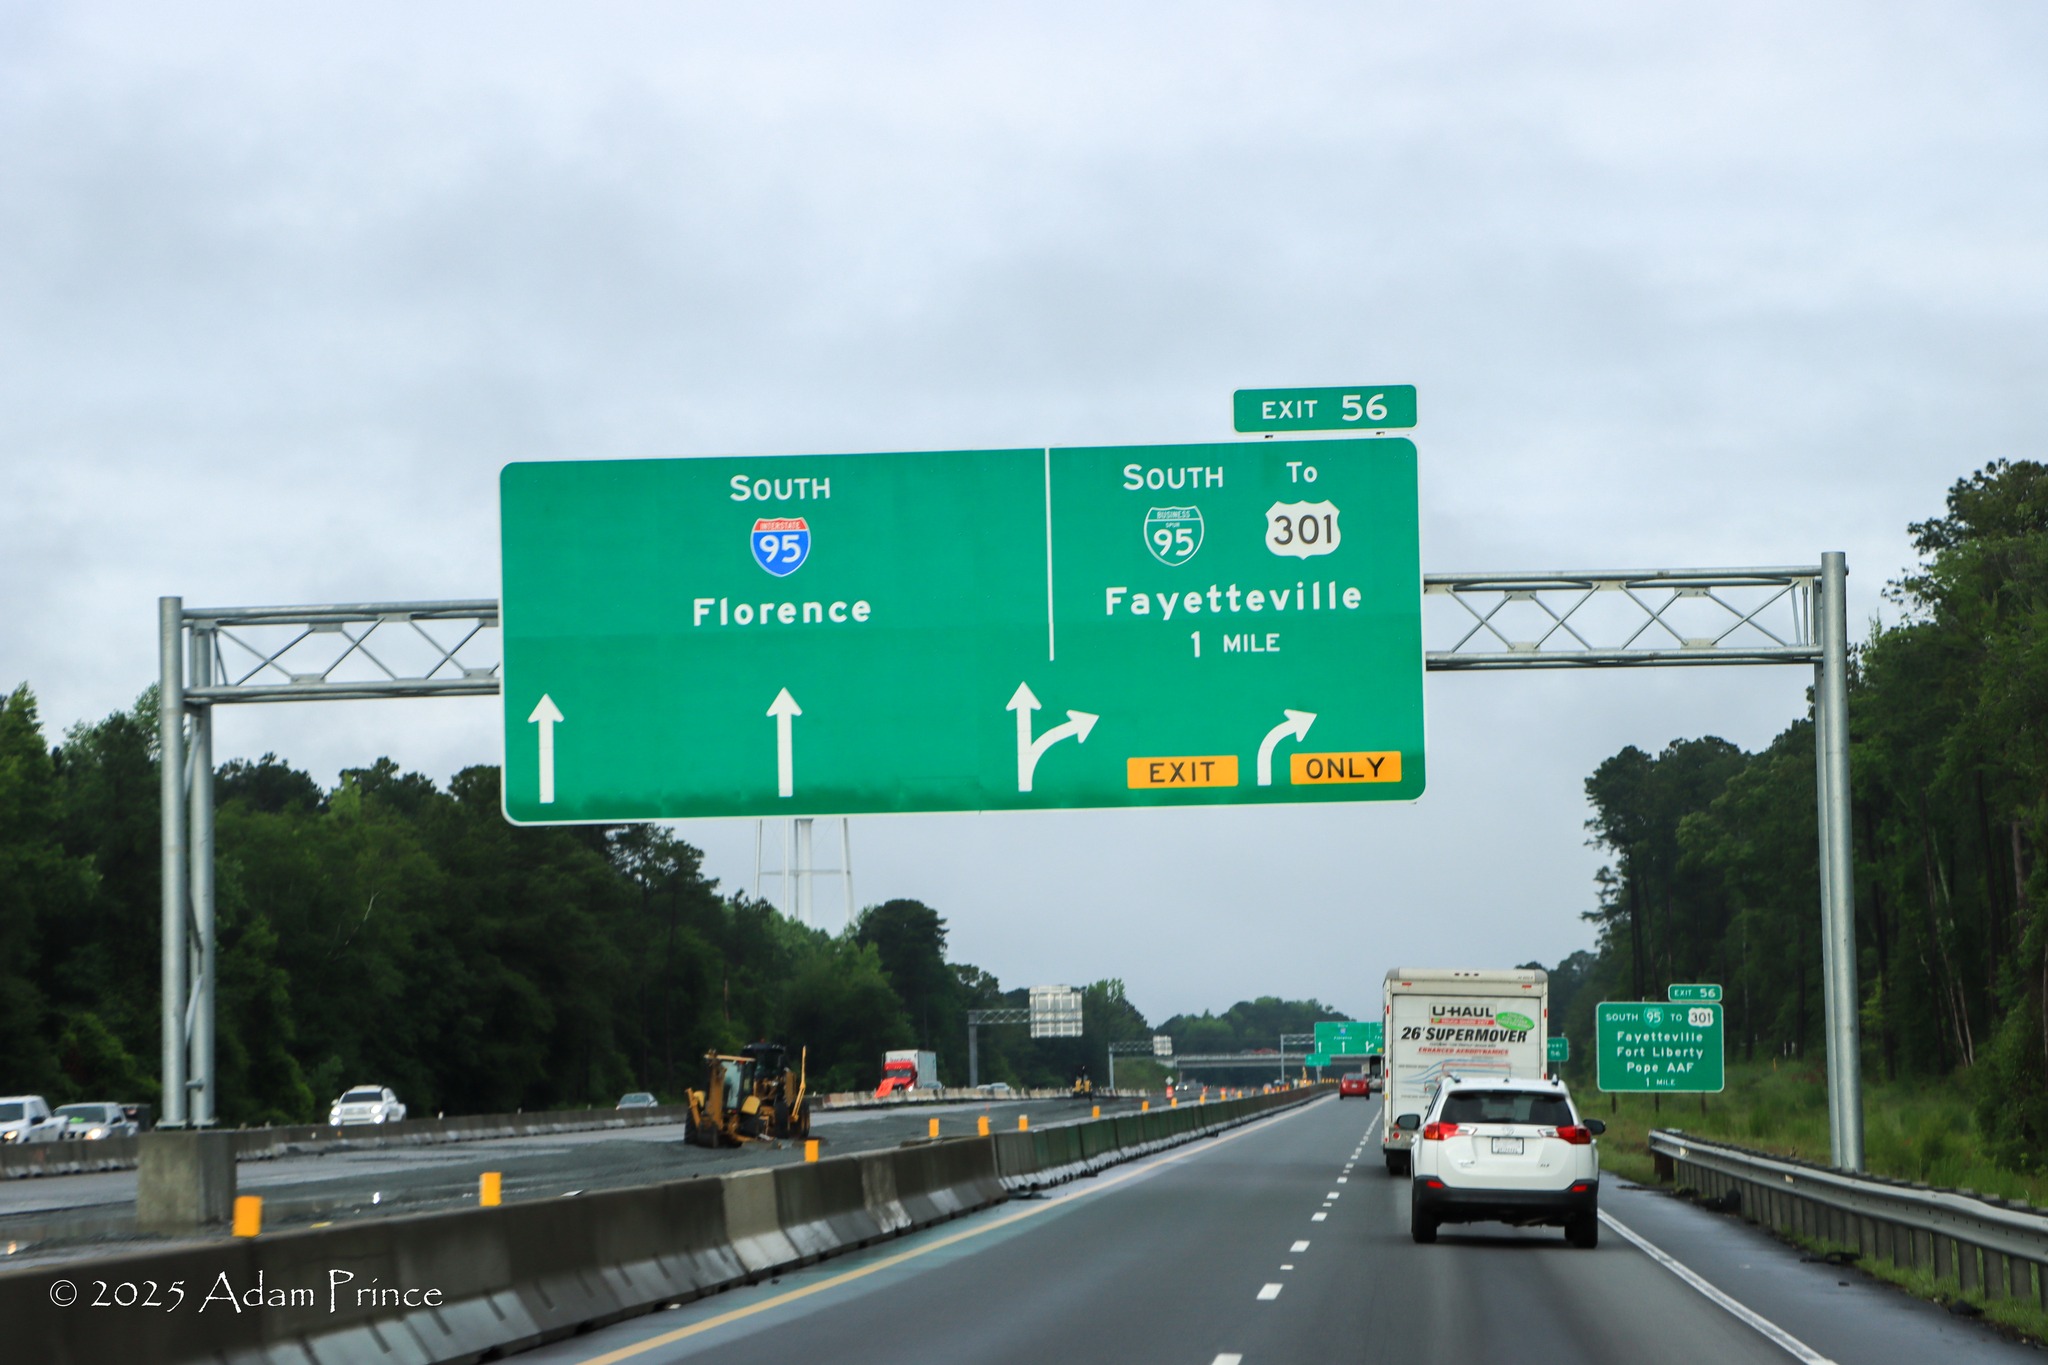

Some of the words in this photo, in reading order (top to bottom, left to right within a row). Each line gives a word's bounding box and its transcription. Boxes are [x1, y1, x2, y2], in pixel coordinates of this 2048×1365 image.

[1261, 399, 1318, 420] EXIT
[1341, 393, 1388, 422] 56
[729, 474, 831, 502] SOUTH
[1122, 463, 1224, 491] SOUTH
[759, 520, 801, 531] INTERSTATE
[1156, 510, 1191, 520] BUSINESS
[1273, 513, 1335, 546] 301
[758, 534, 802, 564] 95
[1153, 528, 1195, 557] 95
[692, 597, 872, 627] Florence
[1104, 581, 1362, 621] Fayetteville
[1190, 631, 1201, 658] 1
[1223, 633, 1281, 653] MILE
[1149, 762, 1216, 784] EXIT
[1305, 756, 1386, 779] ONLY
[1674, 989, 1692, 997] EXIT
[1699, 988, 1716, 998] 56
[1432, 1006, 1494, 1018] U-HAUL
[1605, 1013, 1638, 1022] SOUTH
[1646, 1011, 1661, 1023] 95
[1670, 1013, 1682, 1022] TO
[1690, 1012, 1711, 1023] 301
[1426, 1027, 1528, 1043] SUPERMOVER
[1616, 1031, 1703, 1044] Fayetteville
[1616, 1046, 1645, 1057] Fort
[1652, 1047, 1703, 1060] Liberty
[1626, 1062, 1659, 1075] Pope
[1666, 1062, 1694, 1073] AAF
